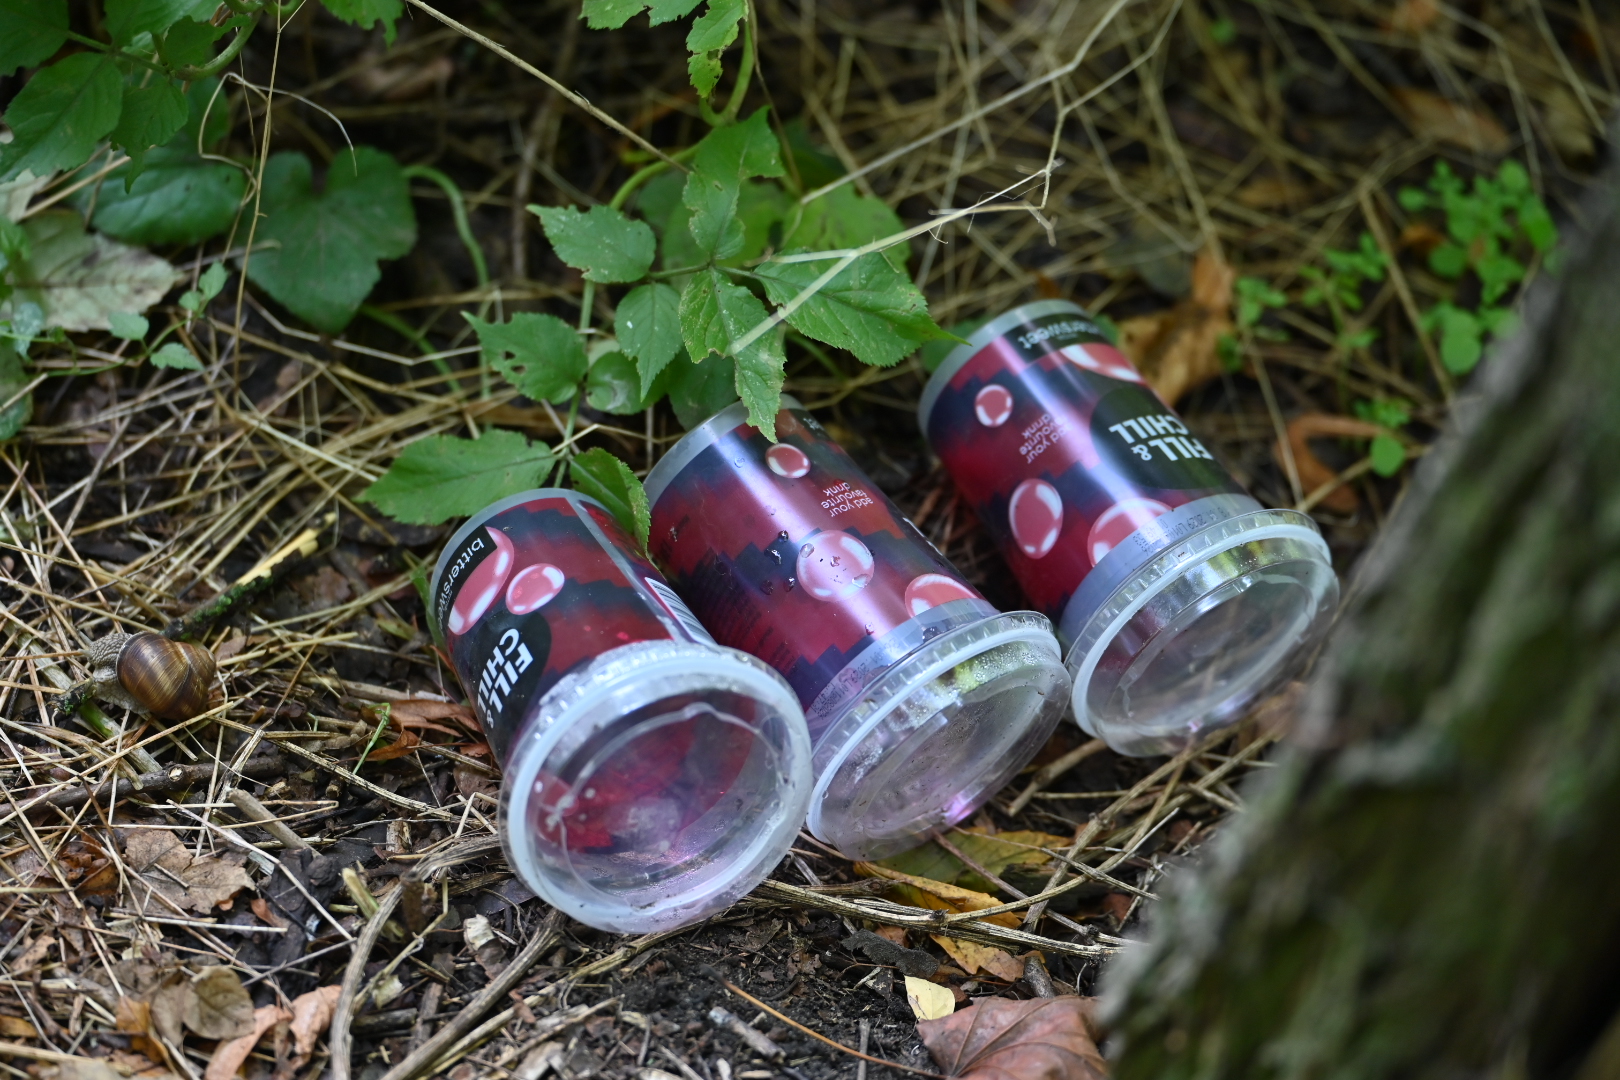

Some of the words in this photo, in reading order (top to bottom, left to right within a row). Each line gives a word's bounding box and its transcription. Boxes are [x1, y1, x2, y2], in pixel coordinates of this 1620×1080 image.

[1108, 414, 1190, 444] CHILL
[1025, 435, 1053, 465] your
[1130, 443, 1153, 461] &
[1148, 435, 1214, 462] FILL
[820, 489, 868, 509] favourite
[822, 481, 851, 498] drink
[829, 498, 855, 518] your
[855, 497, 874, 509] add
[477, 628, 521, 714] CHILL
[488, 642, 534, 714] FILL
[485, 710, 495, 729] &
